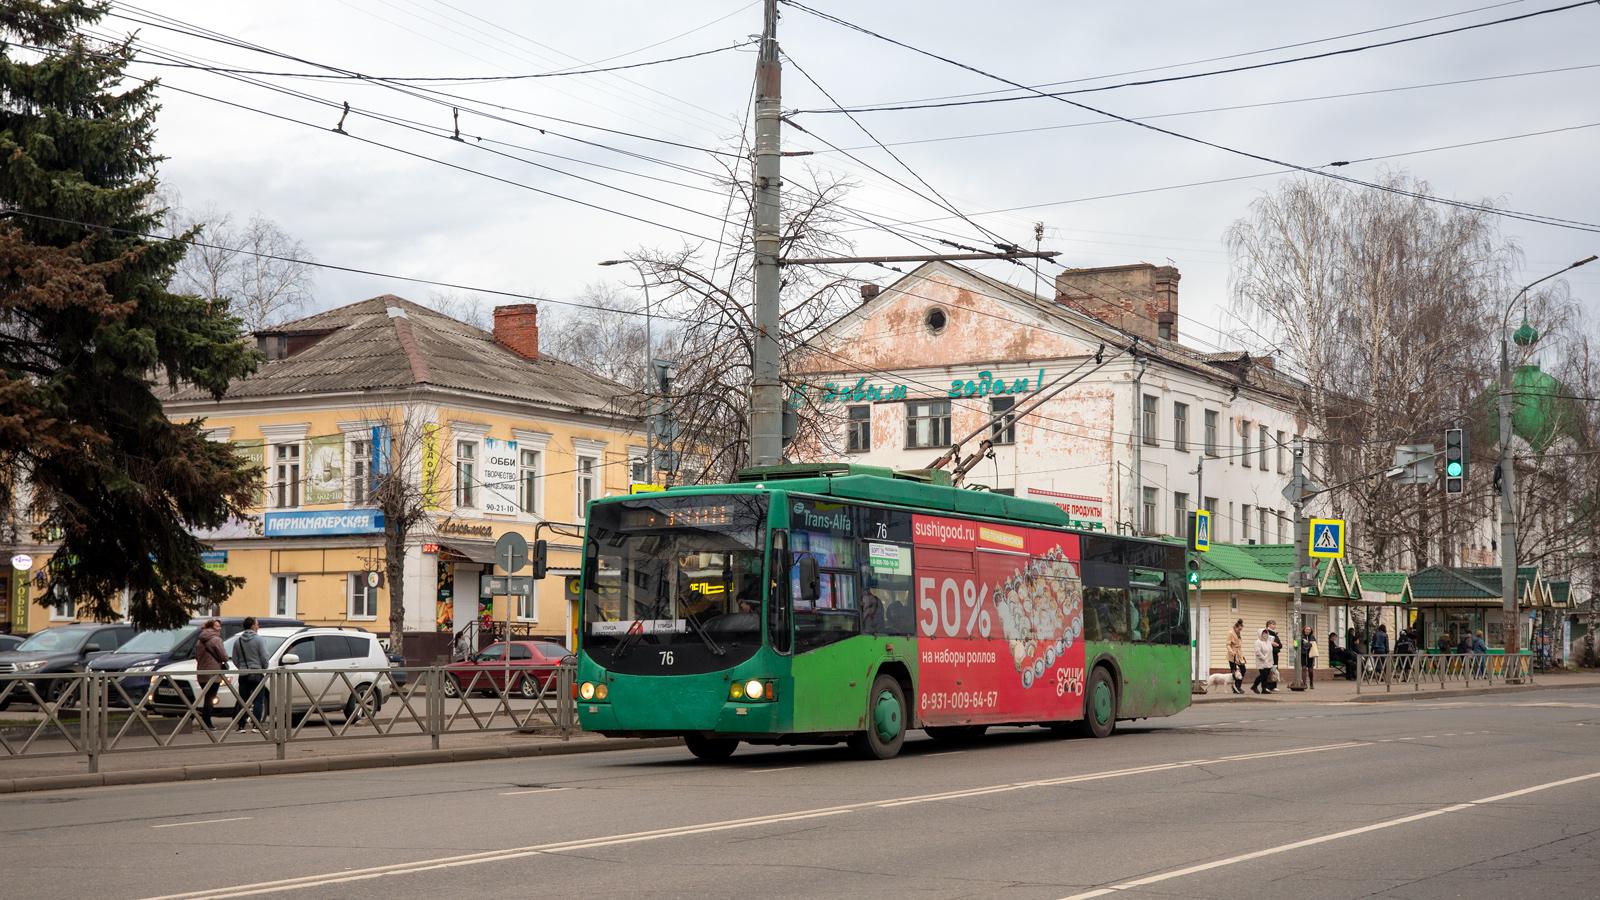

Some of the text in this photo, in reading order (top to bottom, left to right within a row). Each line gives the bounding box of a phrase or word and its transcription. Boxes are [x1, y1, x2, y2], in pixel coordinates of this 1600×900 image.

[485, 456, 516, 467] ХОББИ
[485, 470, 516, 480] ТВОРЧЕСТВО
[316, 492, 343, 502] 902-110
[486, 504, 514, 512] 90-21-10
[1072, 505, 1102, 517] ПРОДУКТЫ
[268, 515, 370, 531] ПАРИКМАХЕРСКАЯ
[804, 509, 851, 531] Trans-Alfa
[876, 522, 887, 539] 76
[915, 521, 975, 543] sushigood.ru
[919, 577, 991, 638] 50%
[659, 651, 674, 665] 76
[922, 649, 996, 667] на наборы роллов
[1056, 667, 1083, 682] СУШИ
[921, 691, 998, 710] 8-931-009-64-67
